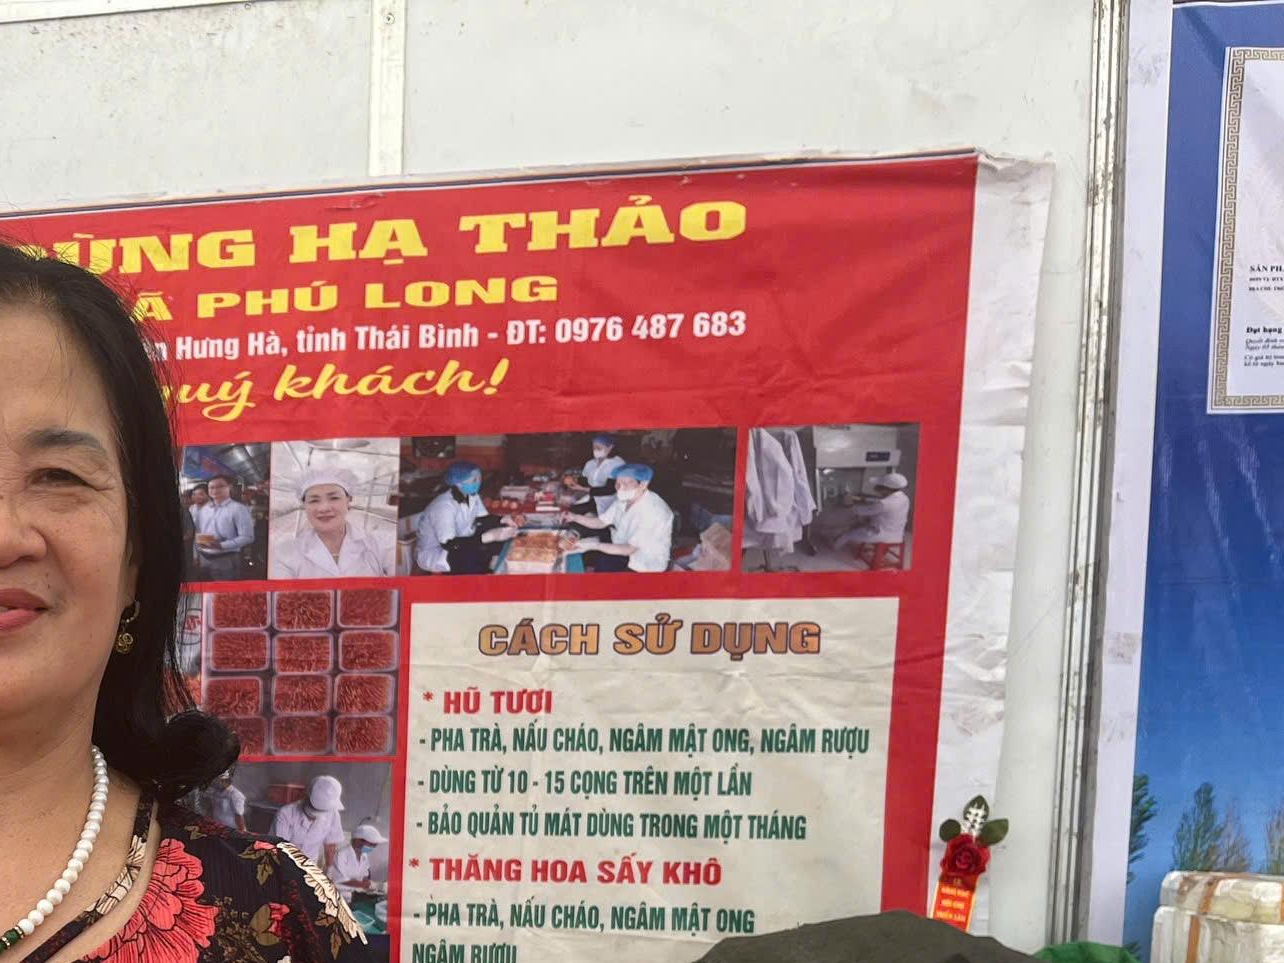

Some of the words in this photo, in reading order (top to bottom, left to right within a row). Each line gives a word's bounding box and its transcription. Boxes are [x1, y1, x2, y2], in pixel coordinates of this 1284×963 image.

[289, 218, 426, 266] HẠ
[459, 195, 746, 254] THẢO
[196, 280, 338, 318] PHÚ
[364, 276, 557, 309] LONG
[175, 331, 240, 359] Hưng
[248, 330, 289, 357] Hà,
[296, 323, 346, 354] tỉnh
[356, 323, 410, 351] Thái
[420, 321, 479, 348] Bình
[505, 319, 548, 346] ĐT:
[554, 316, 623, 344] 0976
[631, 313, 685, 340] 487
[692, 311, 746, 337] 683
[273, 359, 509, 401] khách!
[479, 618, 600, 656] CÁCH
[613, 614, 683, 655] SỬ
[690, 622, 821, 660] DỤNG
[444, 687, 481, 713] HŨ
[489, 690, 553, 713] TƯƠI
[430, 728, 463, 751] PHA
[470, 726, 506, 755] TRÀ,
[512, 720, 548, 751] NẤU
[553, 727, 603, 754] CHÁO,
[609, 726, 662, 752] NGÂM
[668, 728, 708, 758] MẬT
[713, 729, 754, 755] ONG,
[760, 726, 816, 752] NGÂM
[822, 729, 869, 759] RƯỢU
[429, 768, 475, 793] DÙNG
[481, 768, 505, 793] TỪ
[508, 771, 527, 792] 10
[545, 771, 564, 792] 15
[570, 772, 617, 798] CỌNG
[623, 769, 667, 795] TRÊN
[673, 770, 712, 800] MỘT
[428, 804, 461, 835] BẢO
[468, 806, 514, 838] QUẢN
[520, 808, 538, 836] TỦ
[545, 808, 581, 837] MÁT
[587, 809, 634, 837] DÙNG
[640, 813, 698, 838] TRONG
[704, 814, 742, 845] MỘT
[748, 811, 806, 839] THÁNG
[429, 853, 521, 881] THĂNG
[531, 859, 587, 882] HOA
[597, 852, 652, 883] SẤY
[662, 858, 722, 885] KHÔ
[425, 903, 460, 926] PHA
[467, 900, 503, 929] TRÀ,
[510, 895, 545, 927] NẤU
[551, 902, 603, 931] CHÁO,
[610, 901, 665, 931] NGÂM
[671, 906, 711, 936] MẬT
[717, 908, 754, 932] ONG
